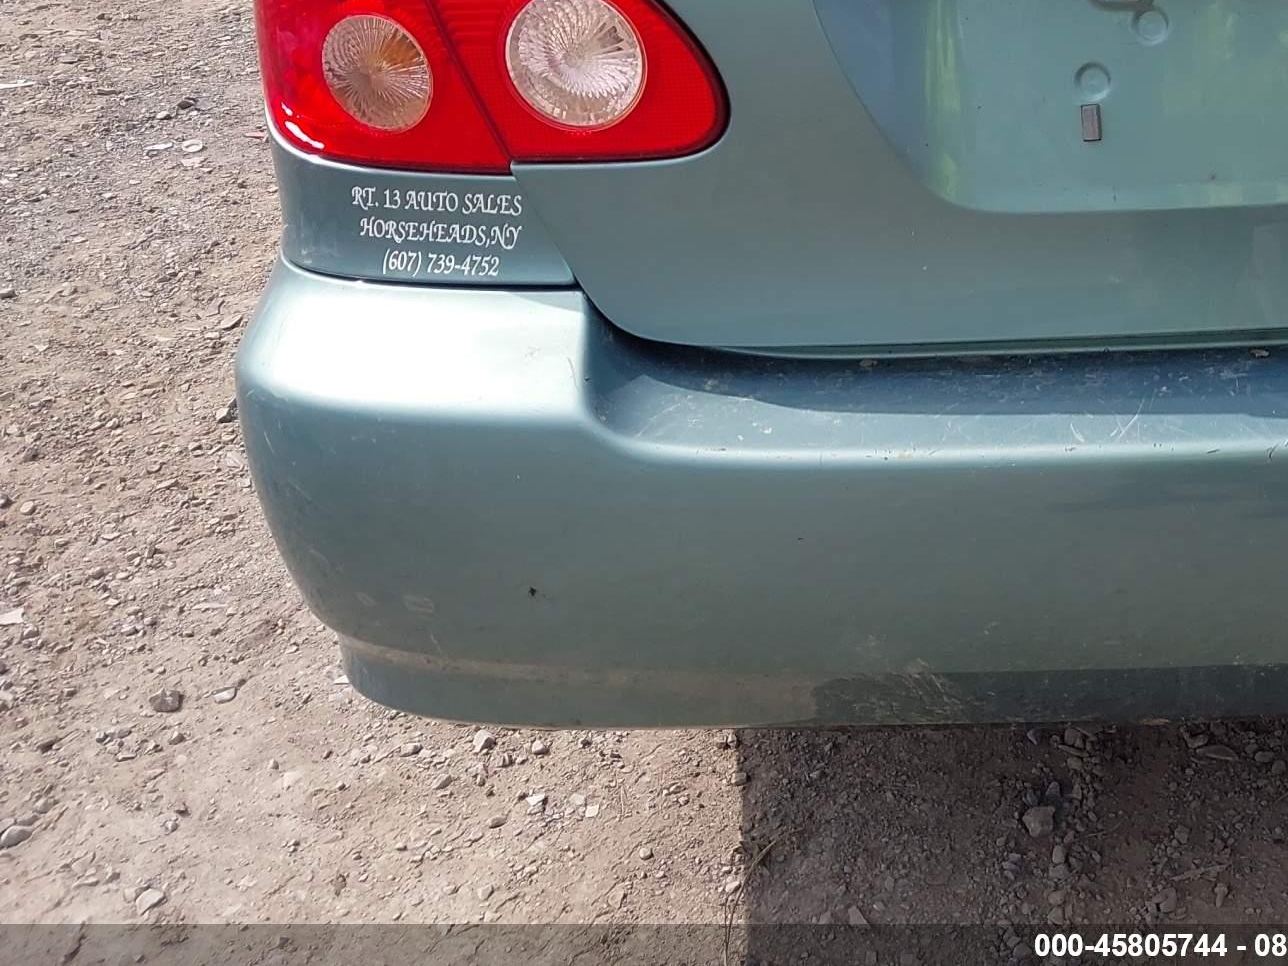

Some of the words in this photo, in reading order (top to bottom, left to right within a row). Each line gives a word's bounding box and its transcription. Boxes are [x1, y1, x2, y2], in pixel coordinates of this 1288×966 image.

[351, 186, 379, 210] RT.
[383, 188, 401, 209] 13
[404, 190, 459, 212] AUTO
[462, 193, 523, 216] SALES
[359, 216, 523, 250] HORSEHEADS,NY
[382, 248, 422, 277] (607)
[428, 251, 500, 277] 739-4752
